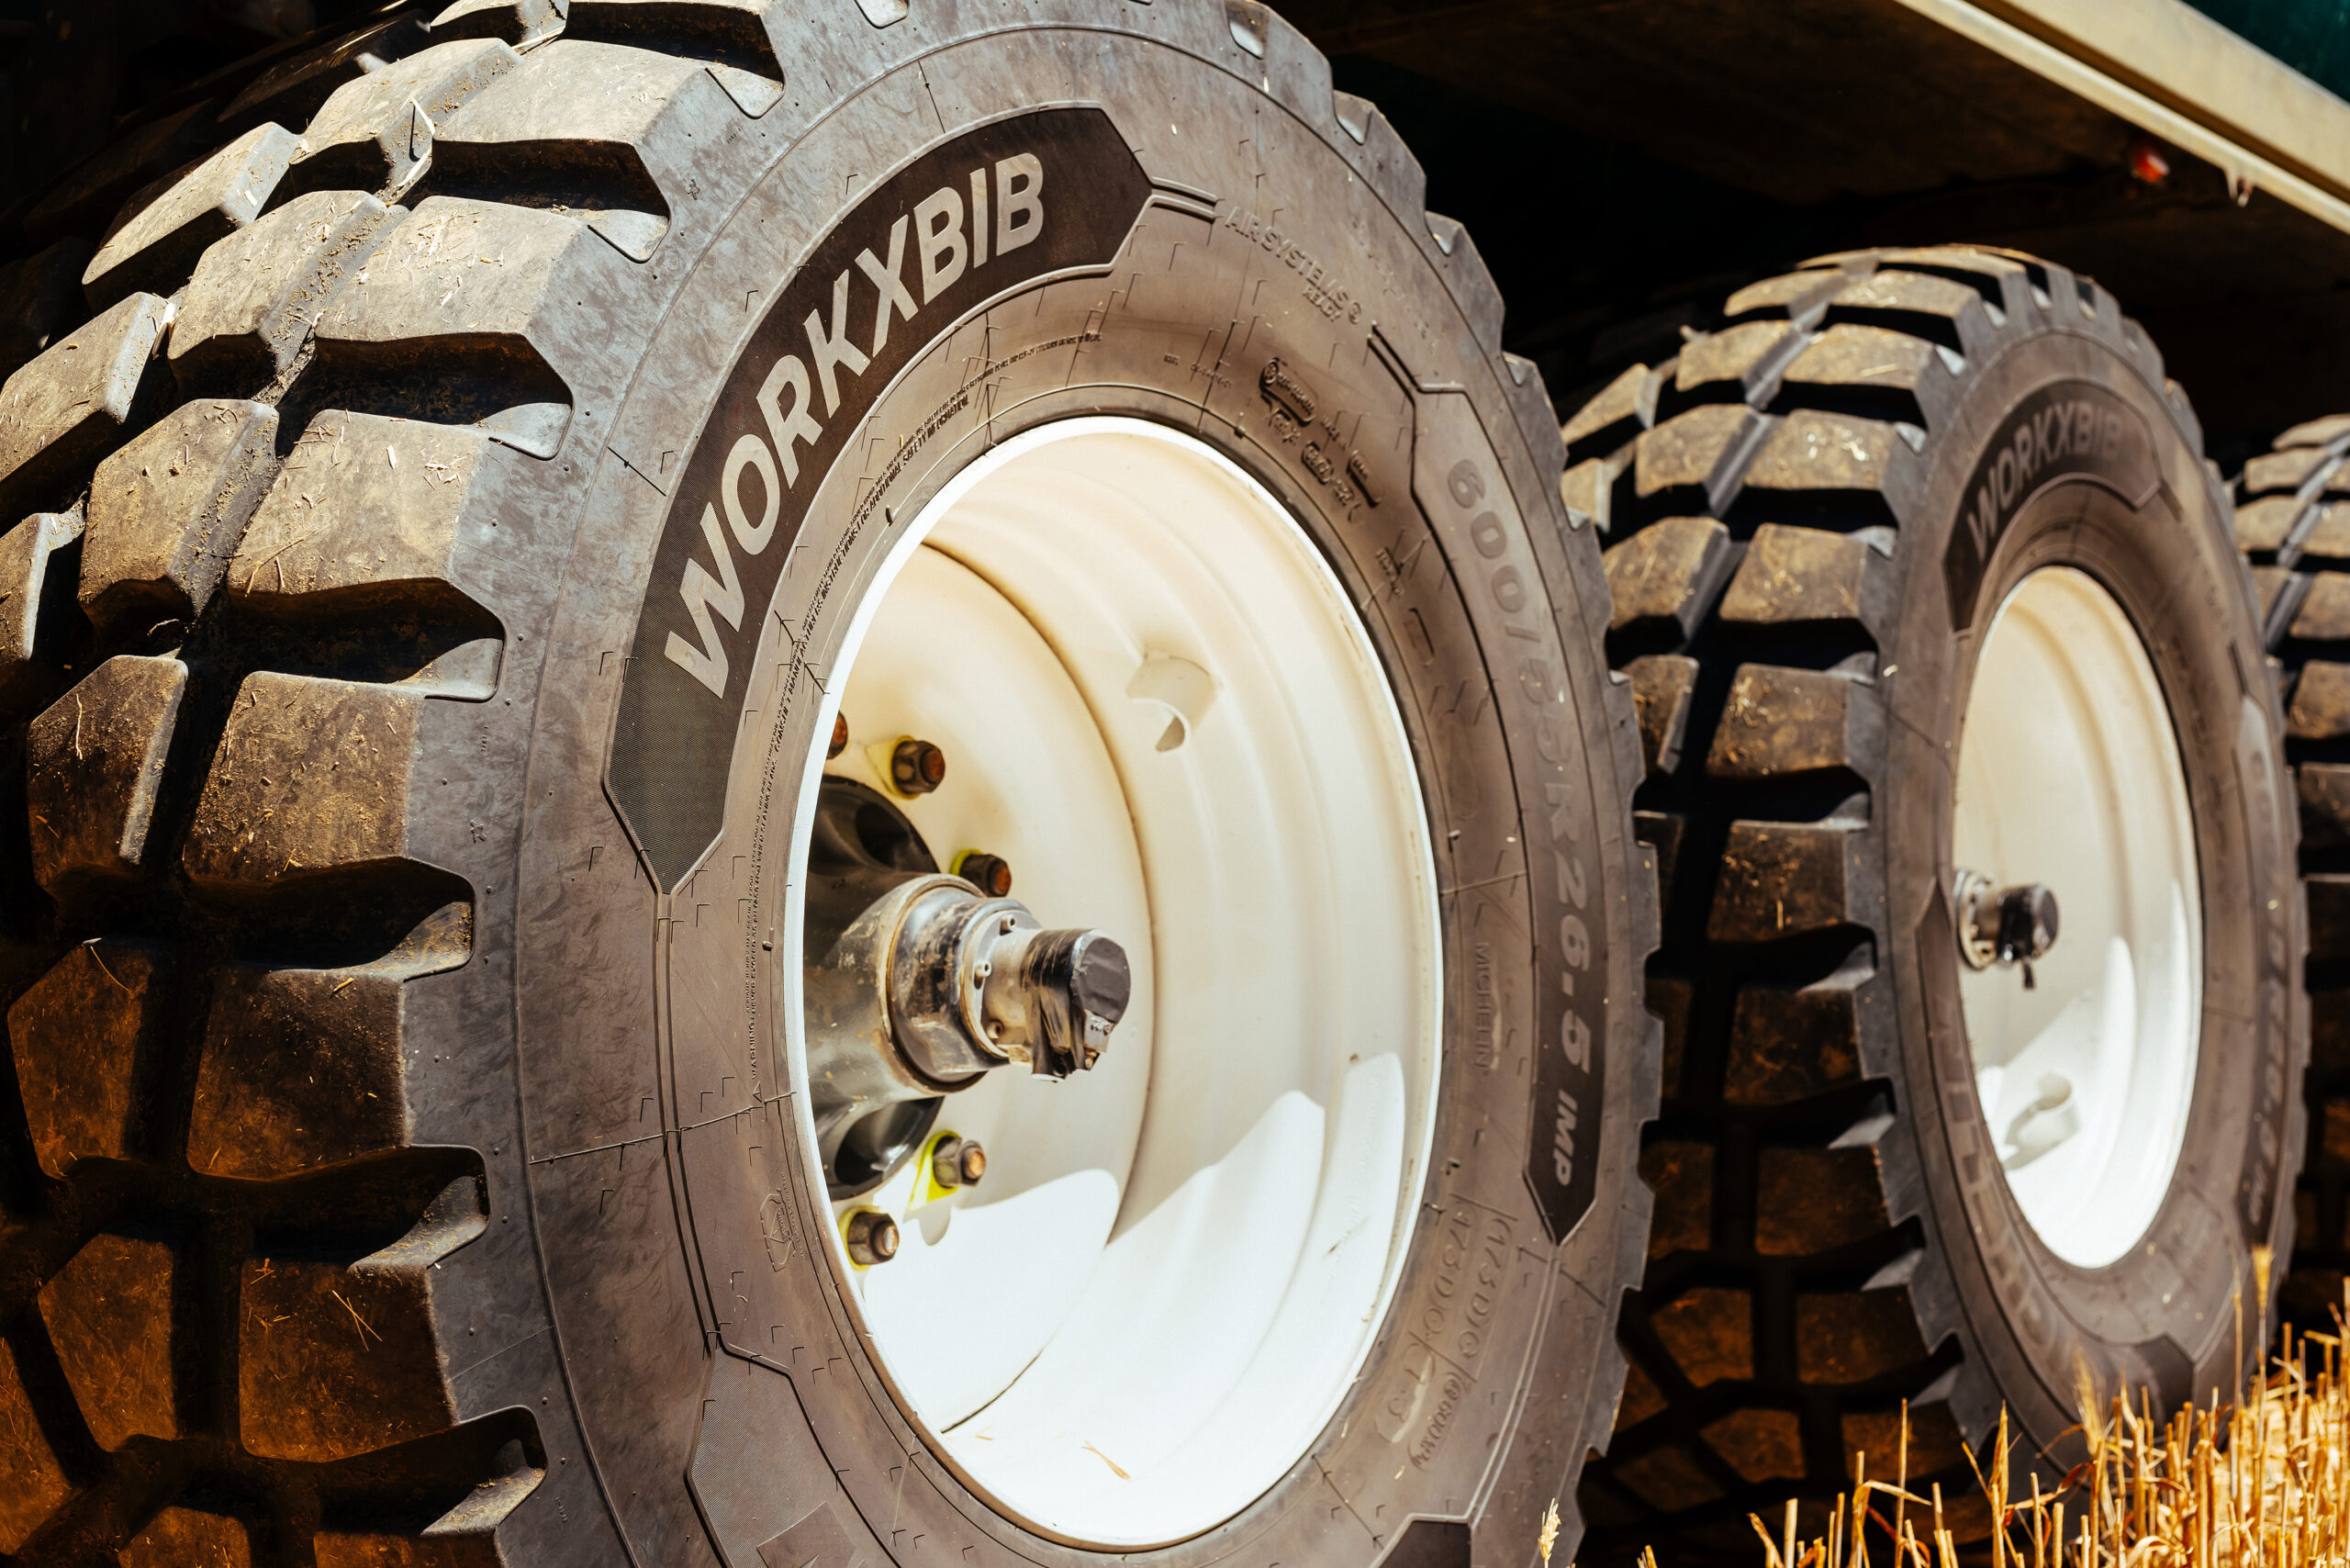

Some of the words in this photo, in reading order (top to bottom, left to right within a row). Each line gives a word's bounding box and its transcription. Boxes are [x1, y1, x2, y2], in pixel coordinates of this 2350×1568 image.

[1225, 206, 1261, 243] AIR
[665, 151, 1045, 699] WORKXBIB
[901, 430, 928, 466] SAFETY
[1966, 400, 2122, 563] WORKXBIB
[1475, 941, 1493, 1068] MICHELIN
[1553, 1089, 1578, 1187] IMP
